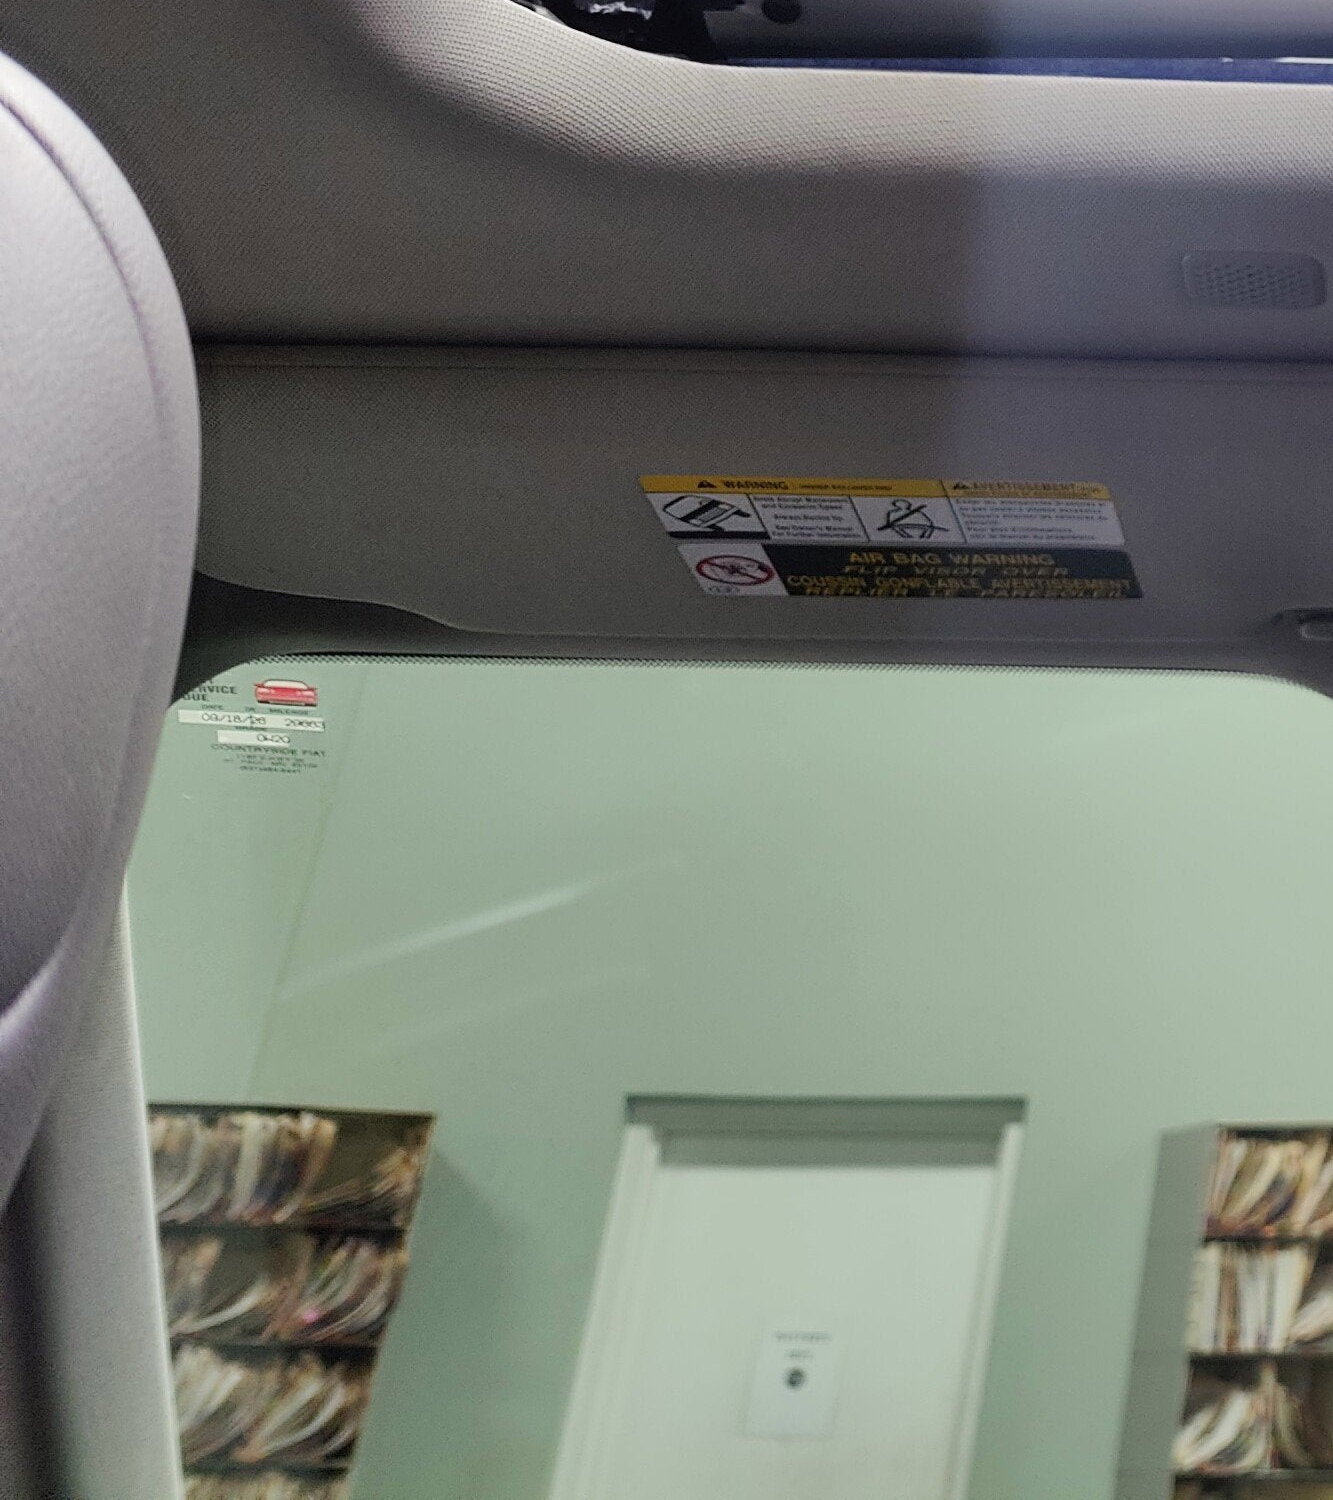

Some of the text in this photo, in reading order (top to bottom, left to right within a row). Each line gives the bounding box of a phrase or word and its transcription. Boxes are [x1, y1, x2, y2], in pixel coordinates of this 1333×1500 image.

[722, 480, 789, 490] WARNING
[849, 552, 1056, 566] AIR BAG WARNING
[843, 565, 1069, 576] FLIP VISOR OVER
[199, 685, 238, 695] RVICE
